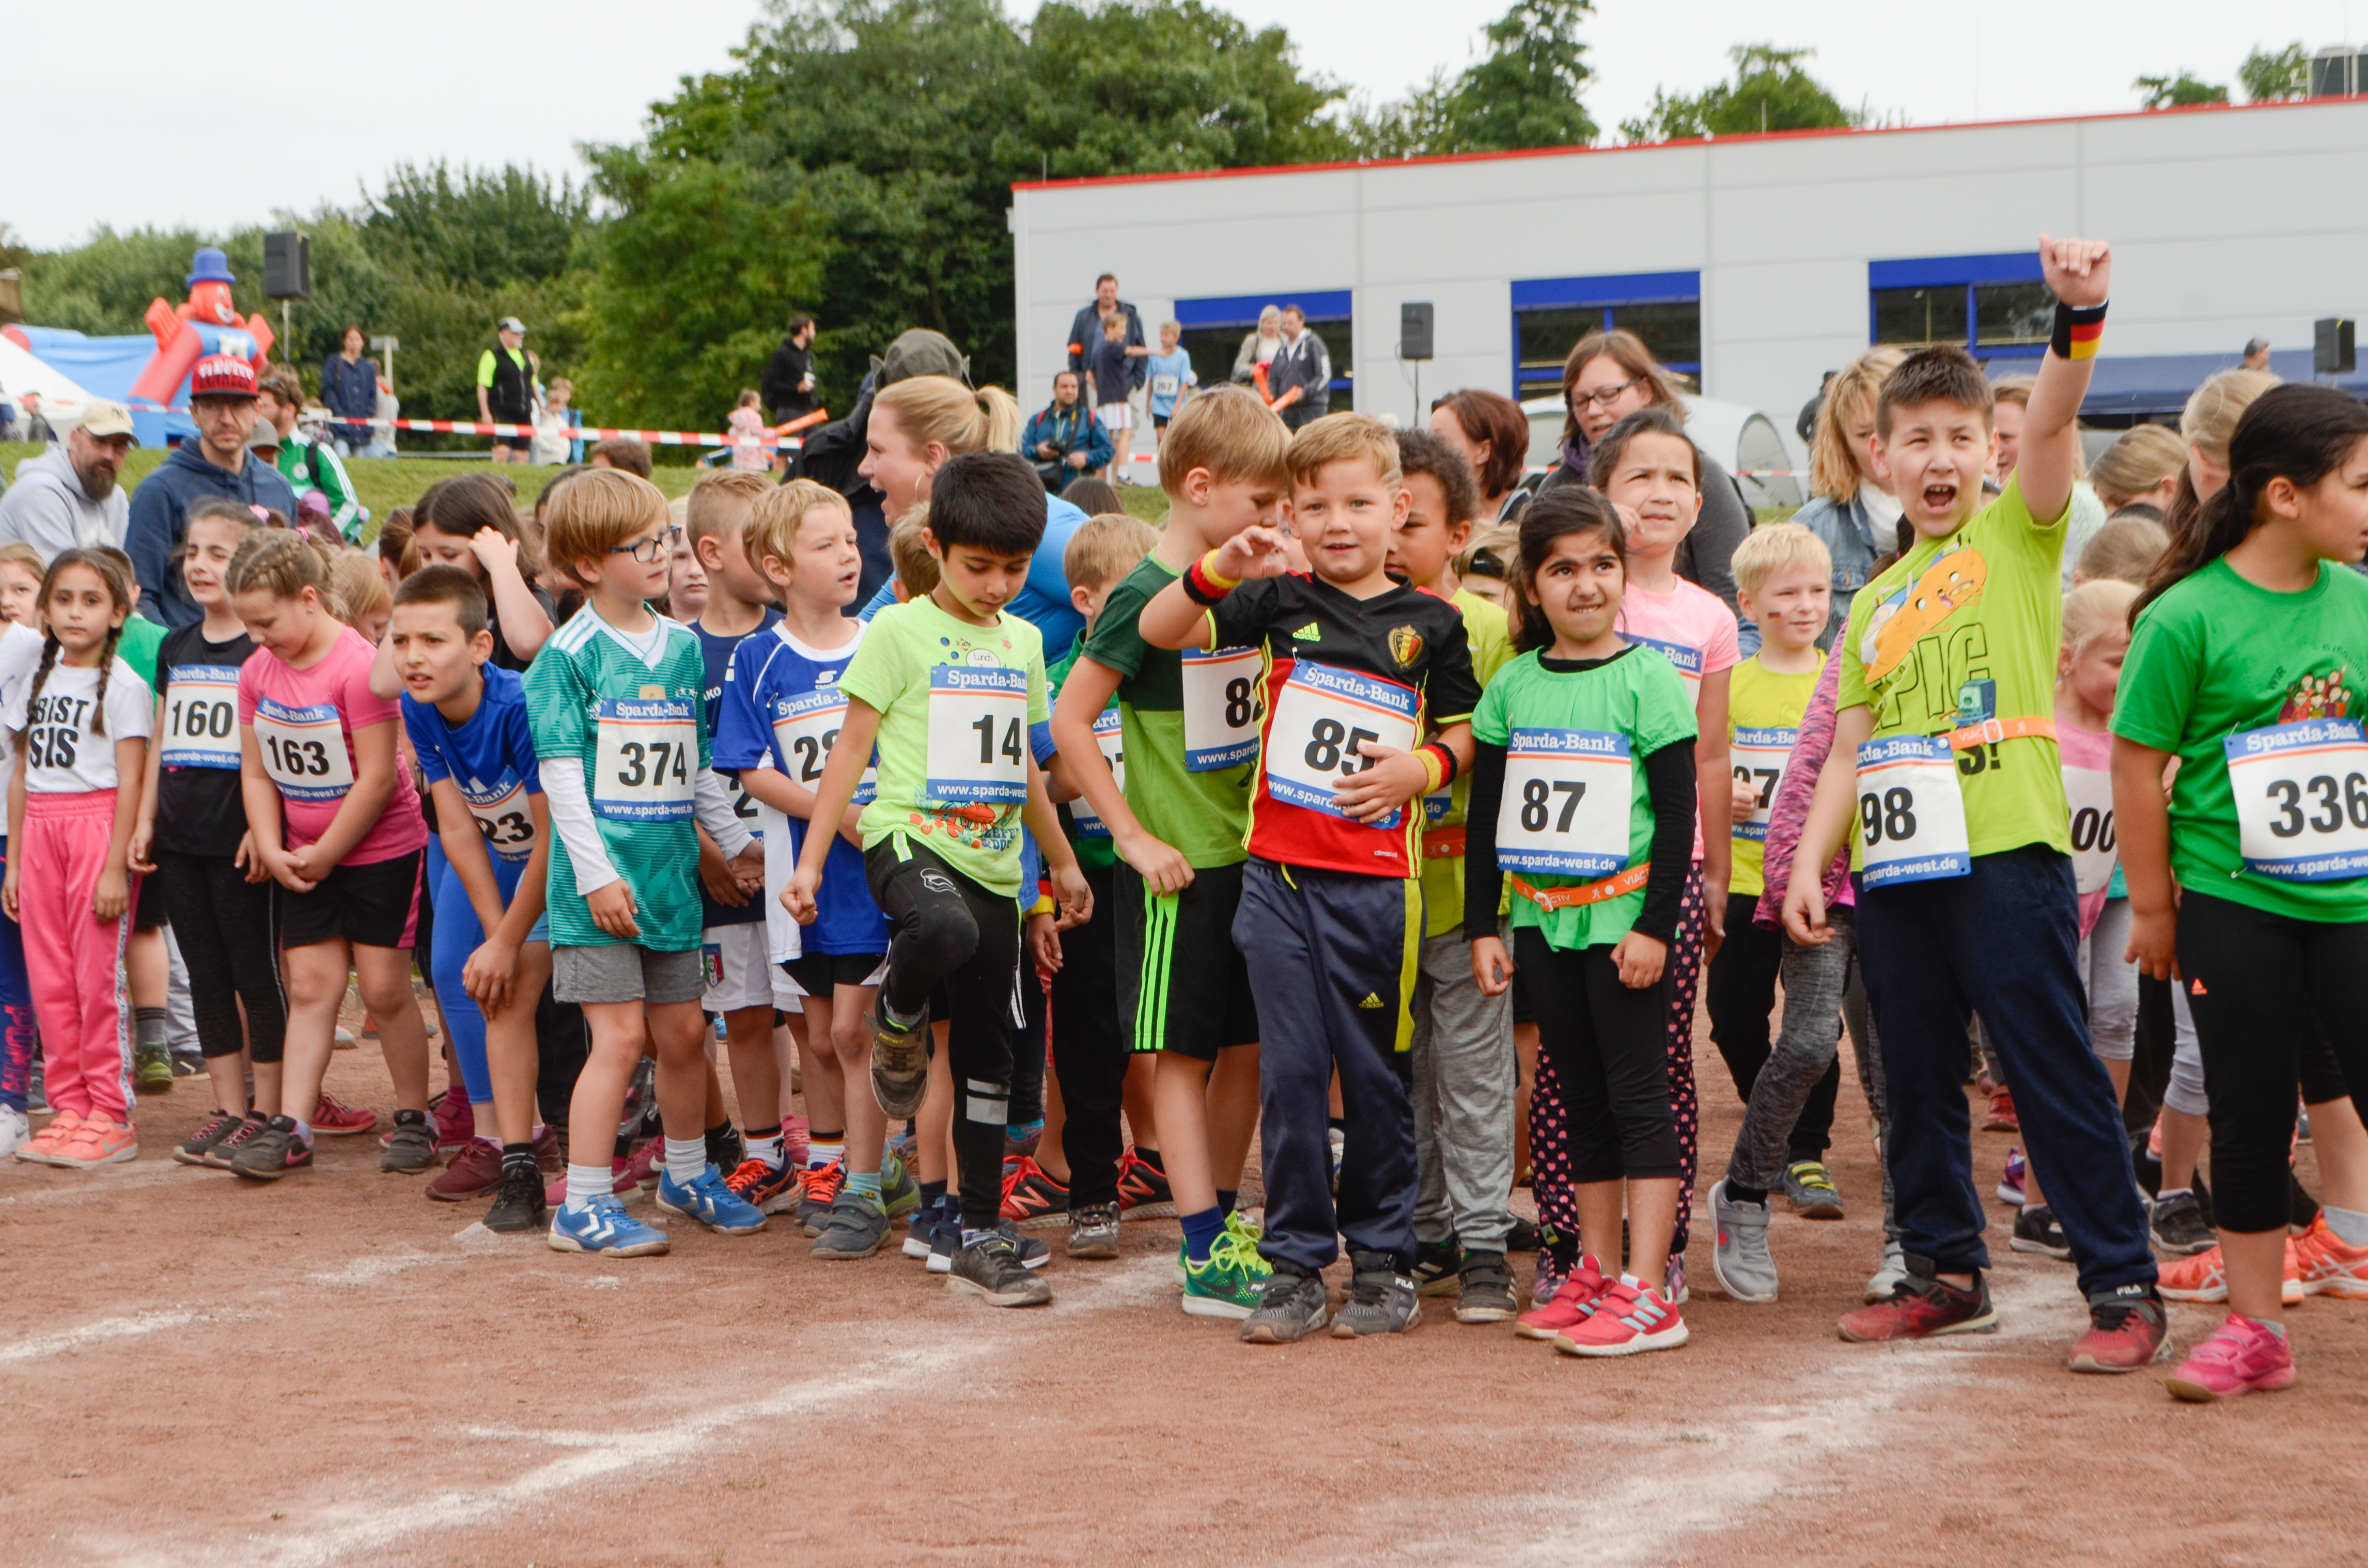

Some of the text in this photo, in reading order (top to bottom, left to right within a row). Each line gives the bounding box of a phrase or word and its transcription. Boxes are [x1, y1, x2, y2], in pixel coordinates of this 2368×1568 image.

[1292, 631, 1321, 642] adidas
[973, 652, 993, 662] Lunch
[947, 669, 1027, 689] Sparda-Ban
[1304, 666, 1410, 711] Sparda-Bank
[1871, 622, 1990, 734] PIC
[615, 702, 689, 719] Sparda-Bank
[777, 689, 850, 717] Sparda-B
[172, 700, 233, 738] 160
[30, 727, 78, 769] SIS
[973, 715, 1022, 766] 14
[1304, 718, 1380, 777] 85
[1512, 732, 1616, 752] Sparda-Bank
[1857, 740, 1934, 763] rda-Bank
[2246, 722, 2360, 752] Sparda-Bank
[267, 735, 330, 776] 163
[618, 742, 687, 787] 374
[937, 785, 1027, 798] www.sparda-west
[1521, 778, 1586, 833] 87
[2267, 772, 2368, 838] 336
[603, 804, 693, 818] www.sparda-west.de
[1861, 787, 1917, 847] 98
[2071, 807, 2116, 853] 00
[1499, 854, 1617, 871] www.sparda-west.de
[1395, 1277, 1414, 1290] FILA
[2116, 1283, 2142, 1297] FILA
